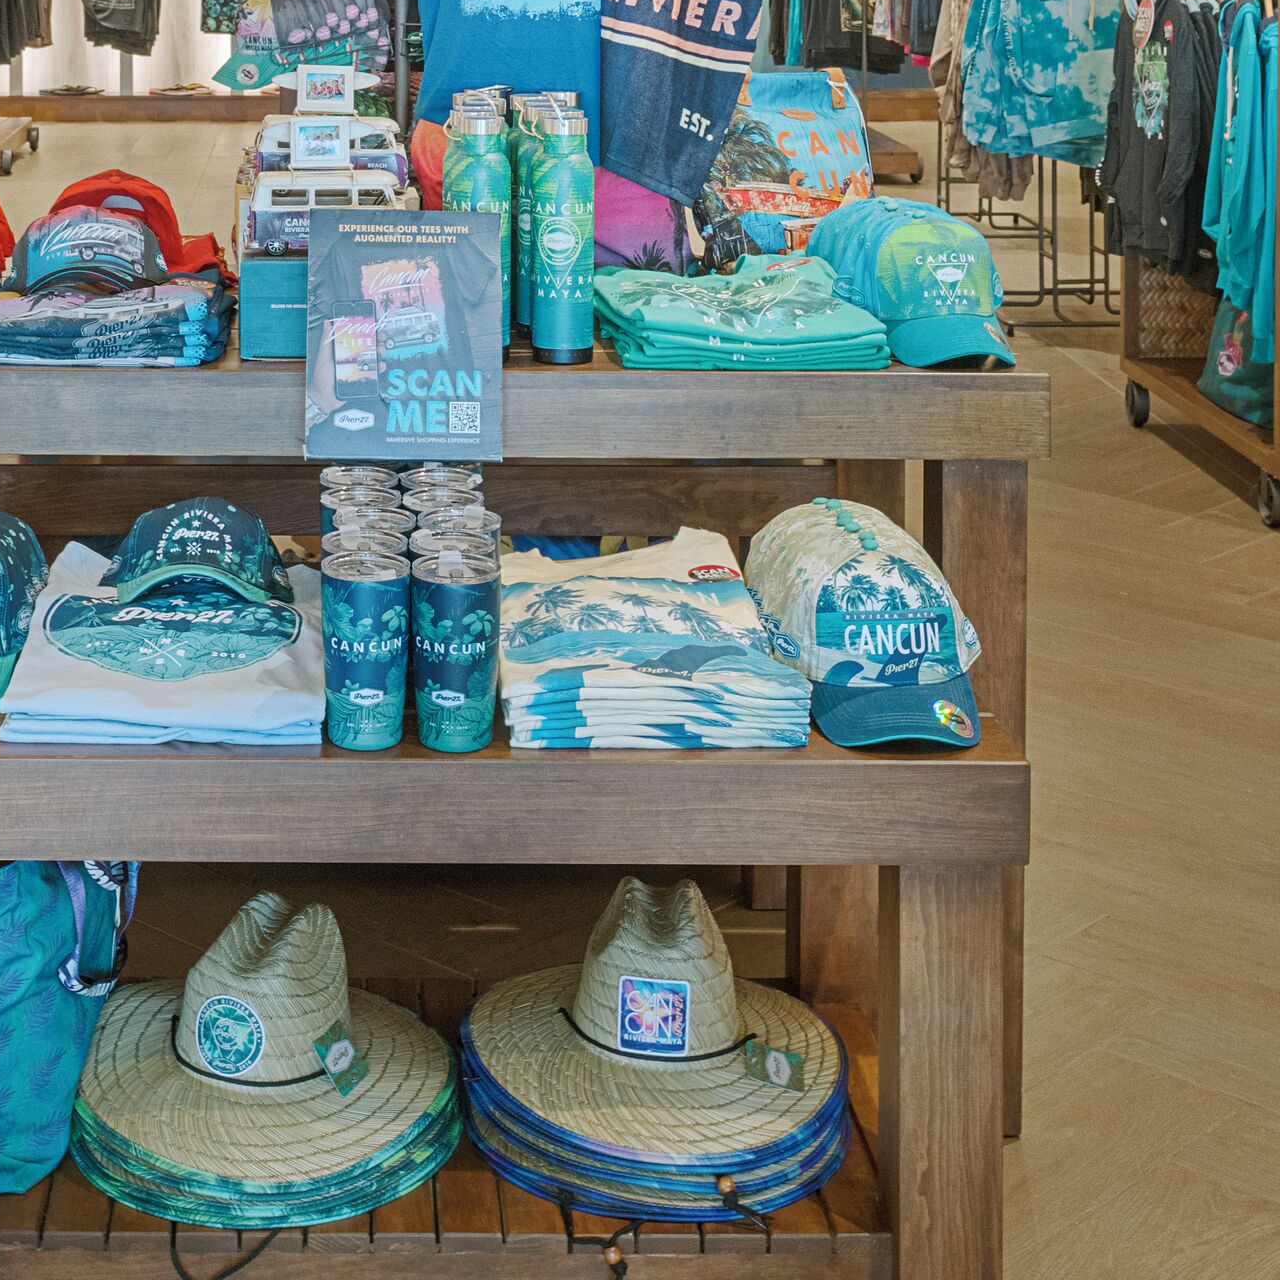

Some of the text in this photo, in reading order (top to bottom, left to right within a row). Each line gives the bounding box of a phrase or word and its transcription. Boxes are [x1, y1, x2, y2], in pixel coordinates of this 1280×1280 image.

[244, 36, 273, 46] CANCUN
[678, 108, 713, 141] EST.
[777, 129, 861, 158] CAN
[788, 169, 872, 200] CUN
[453, 200, 509, 212] ANCUN
[533, 202, 593, 215] ANCUN
[284, 218, 310, 228] CAN
[338, 224, 469, 234] EXPERIENCE OUR TEES WITH
[40, 220, 125, 256] Cancun
[354, 234, 457, 243] AUGMENTED REALITY!
[915, 253, 975, 265] CANCUN
[369, 266, 430, 294] Cancun
[538, 289, 582, 299] MAYA
[935, 298, 968, 306] MAYA
[95, 314, 143, 337] Pier27
[323, 310, 389, 346] Beach
[342, 338, 374, 347] LIFE
[387, 369, 482, 397] SCAN
[386, 400, 447, 433] ME
[156, 509, 233, 563] CANCUN RIVIERA MAYA
[331, 637, 402, 653] CANCUN
[415, 636, 486, 655] CANCUN
[845, 622, 940, 656] CANCUN
[211, 651, 246, 659] 2010
[885, 658, 920, 676] Pier27
[220, 997, 251, 1016] RIVIERA
[626, 990, 672, 1013] CAN
[625, 1012, 672, 1038] CUN
[624, 1033, 683, 1046] RIVIERA MAYA
